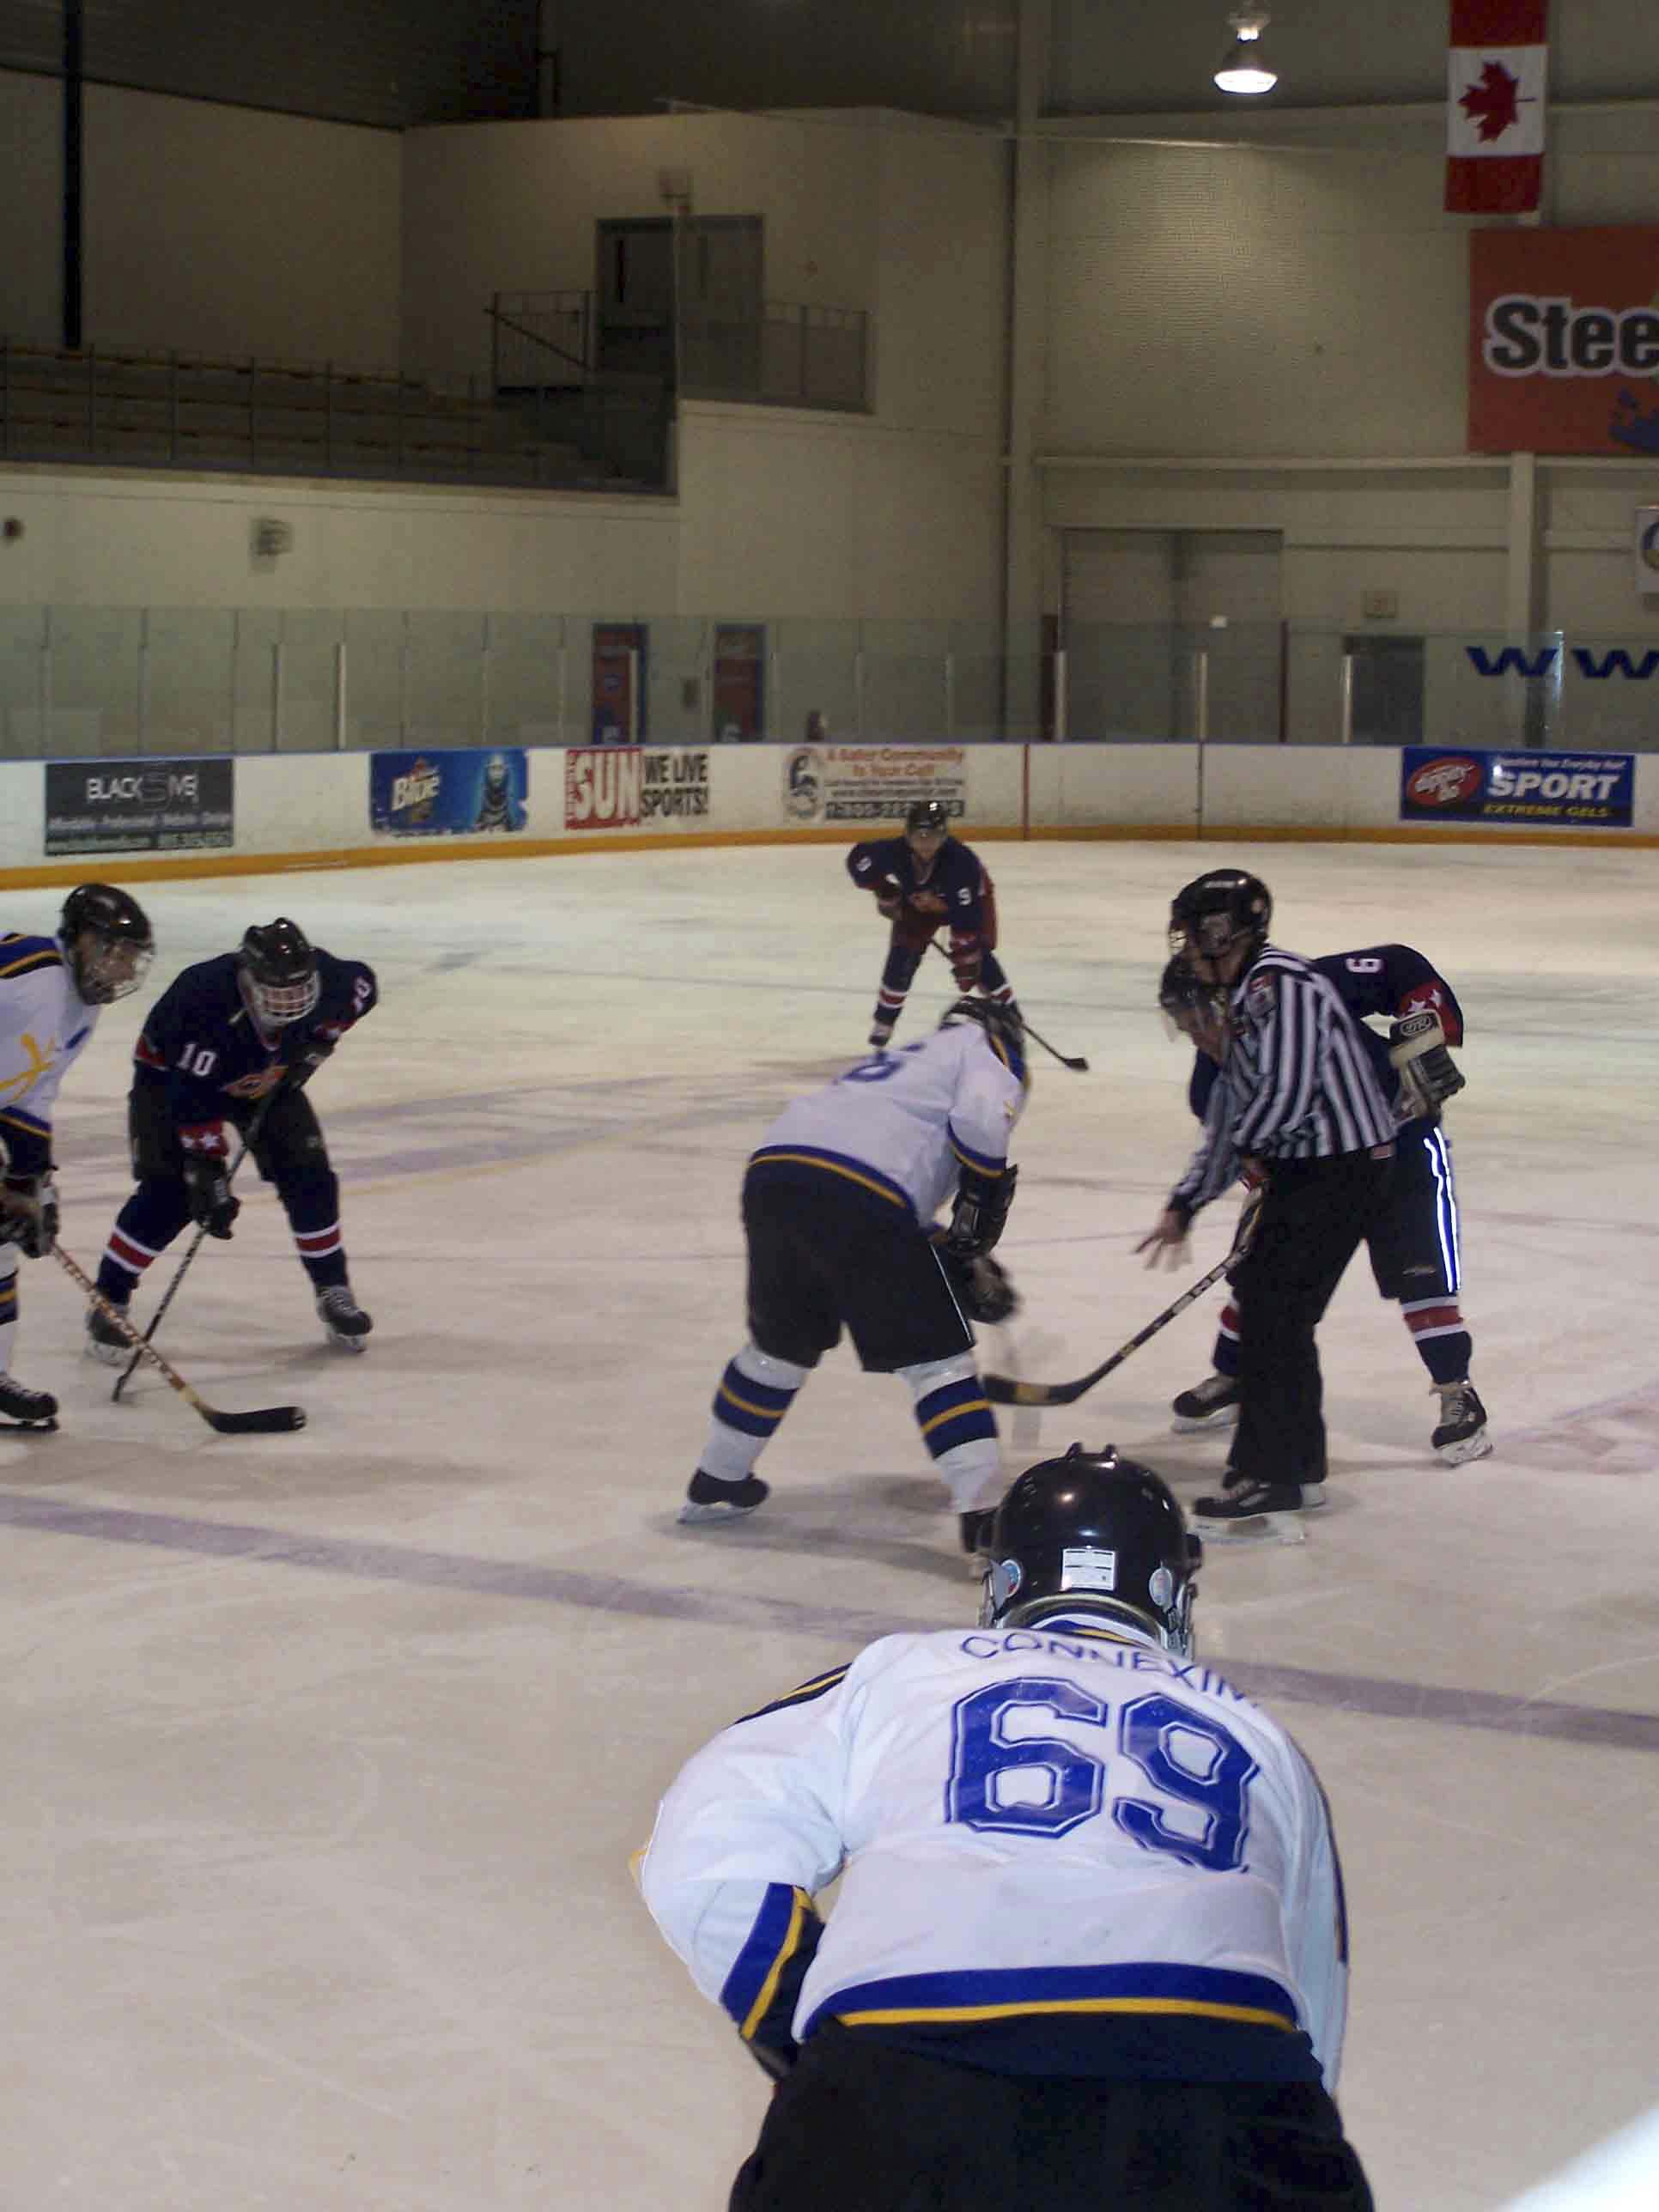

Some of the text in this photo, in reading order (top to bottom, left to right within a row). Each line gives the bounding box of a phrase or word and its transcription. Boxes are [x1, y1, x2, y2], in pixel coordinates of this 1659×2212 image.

[645, 753, 708, 785] WE LIVE
[1487, 770, 1620, 801] SPORT
[576, 753, 640, 820] SUN
[1483, 803, 1611, 818] EXTREME GELS
[176, 1042, 217, 1077] 10
[945, 1676, 1261, 1874] 69
